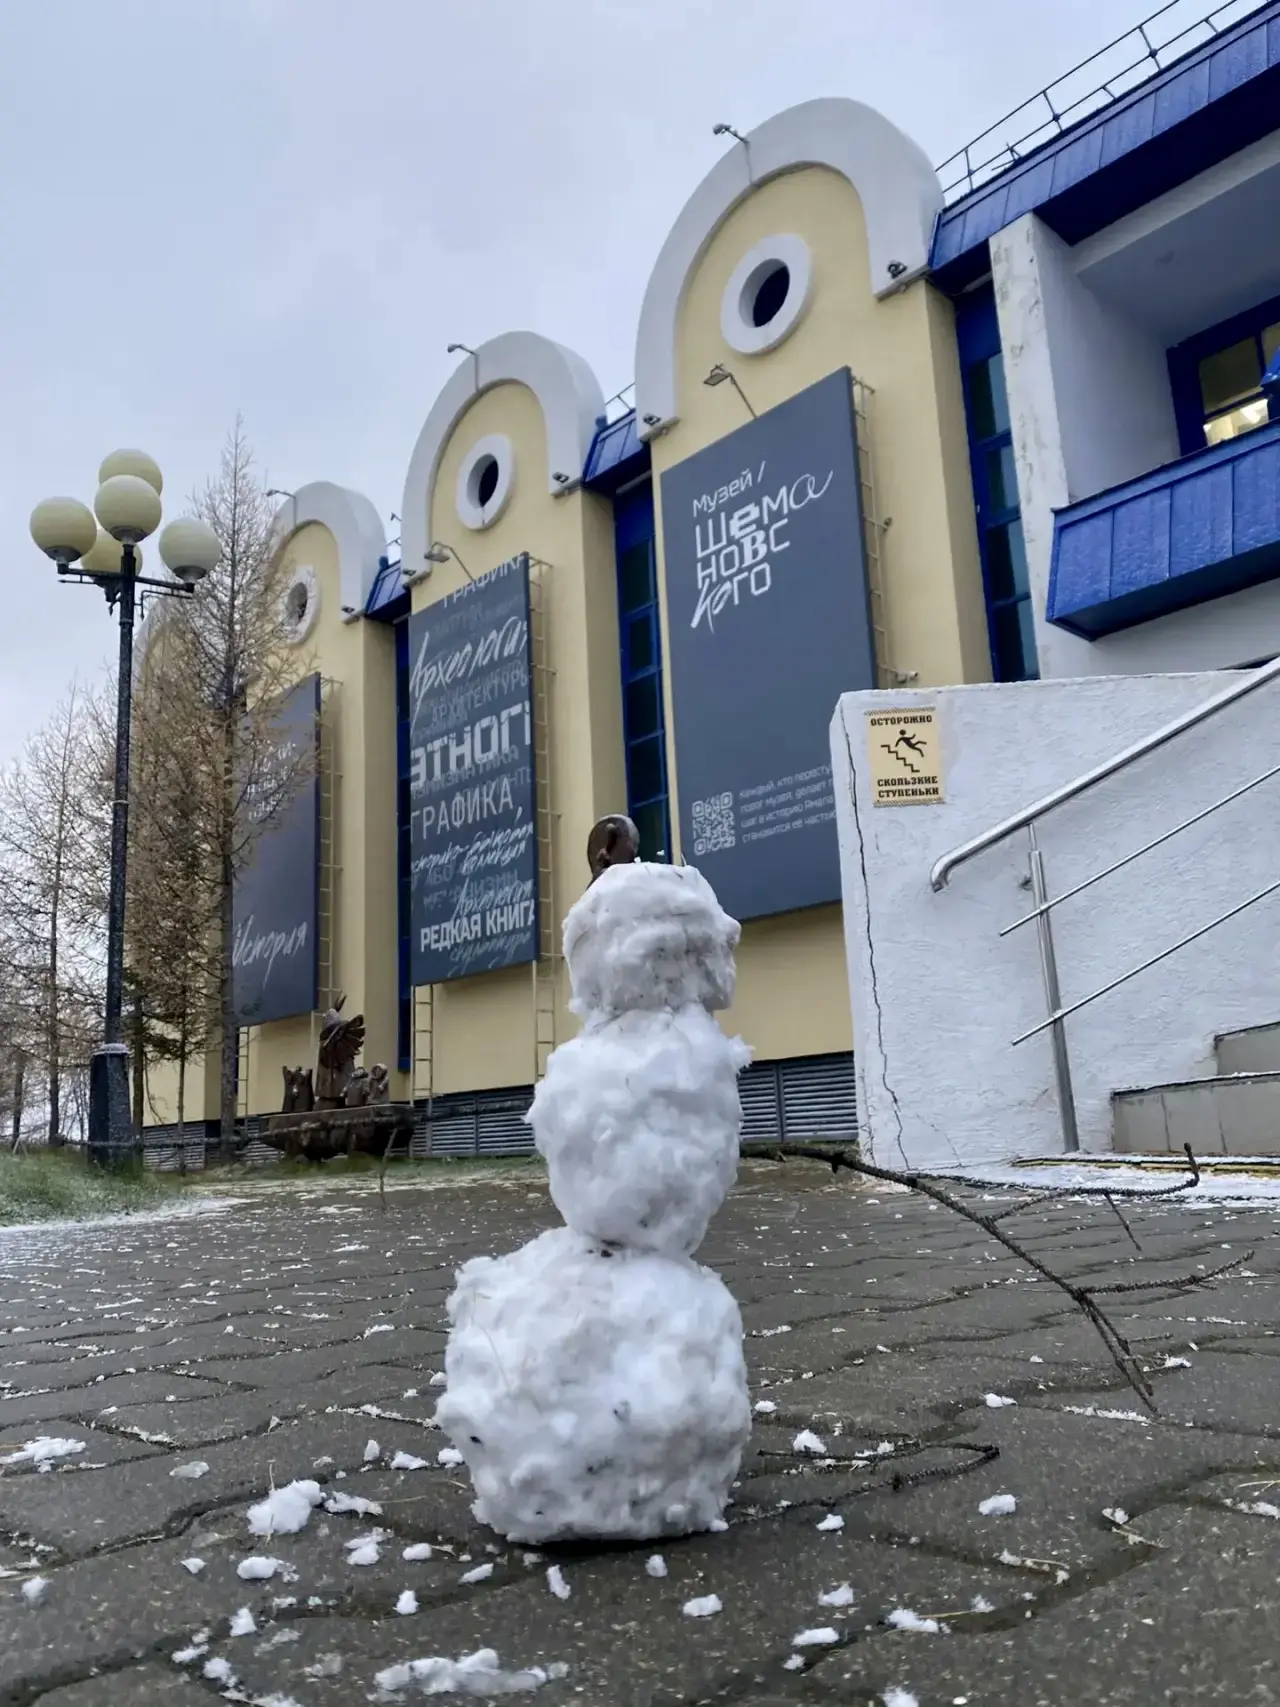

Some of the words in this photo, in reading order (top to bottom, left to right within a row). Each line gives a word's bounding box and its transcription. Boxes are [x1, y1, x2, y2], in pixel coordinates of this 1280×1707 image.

[692, 468, 753, 518] Музей
[870, 714, 933, 727] ОСТОРОЖНО
[794, 765, 832, 781] пересту
[877, 775, 938, 787] СКОЛЬЗКИЕ
[878, 787, 939, 798] СТУПЕНЬКИ
[420, 912, 482, 953] РЕДКАЯ
